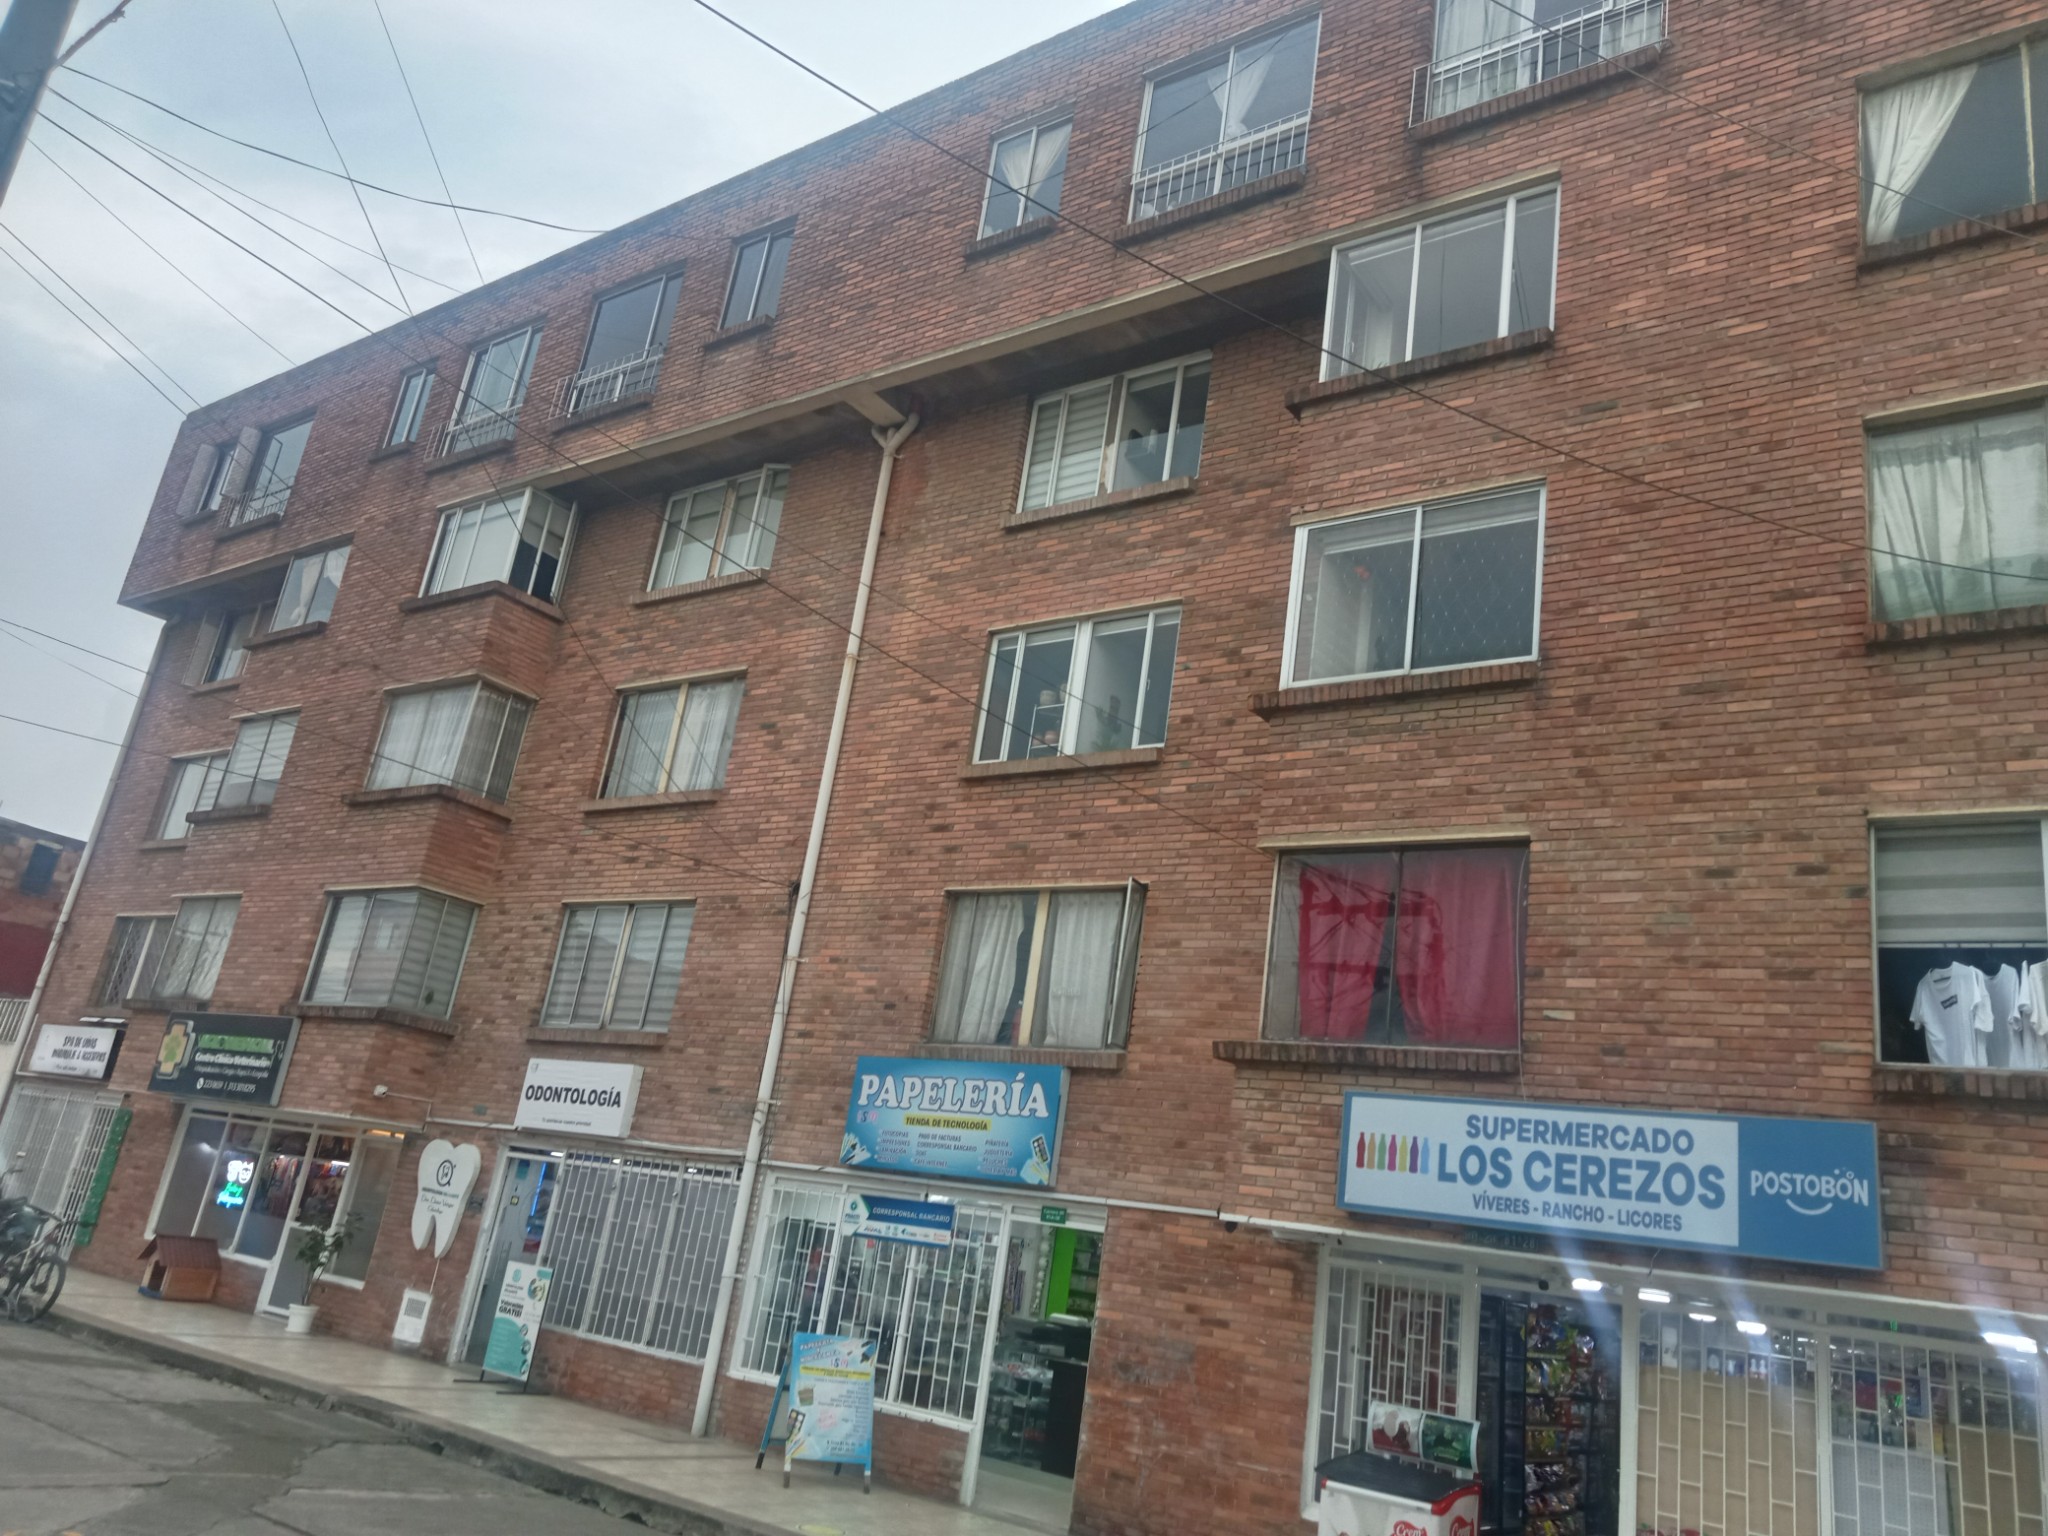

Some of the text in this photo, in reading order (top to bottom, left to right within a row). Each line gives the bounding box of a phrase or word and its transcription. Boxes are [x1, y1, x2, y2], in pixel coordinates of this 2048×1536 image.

[525, 1084, 621, 1108] ODONTOLOGÍA
[857, 1072, 1050, 1118] PAPELERÍA
[906, 1116, 988, 1131] TIENDA DE TECNOLOGÍA
[1465, 1114, 1694, 1156] SUPERMERCADO
[1438, 1143, 1726, 1210] LOS CEREZOS
[872, 1206, 917, 1219] CORRESPONSAL
[919, 1211, 951, 1224] BANCARIO
[1472, 1190, 1530, 1216] VÍVERES
[1542, 1201, 1605, 1224] RANCHO
[1617, 1208, 1683, 1232] LICORES
